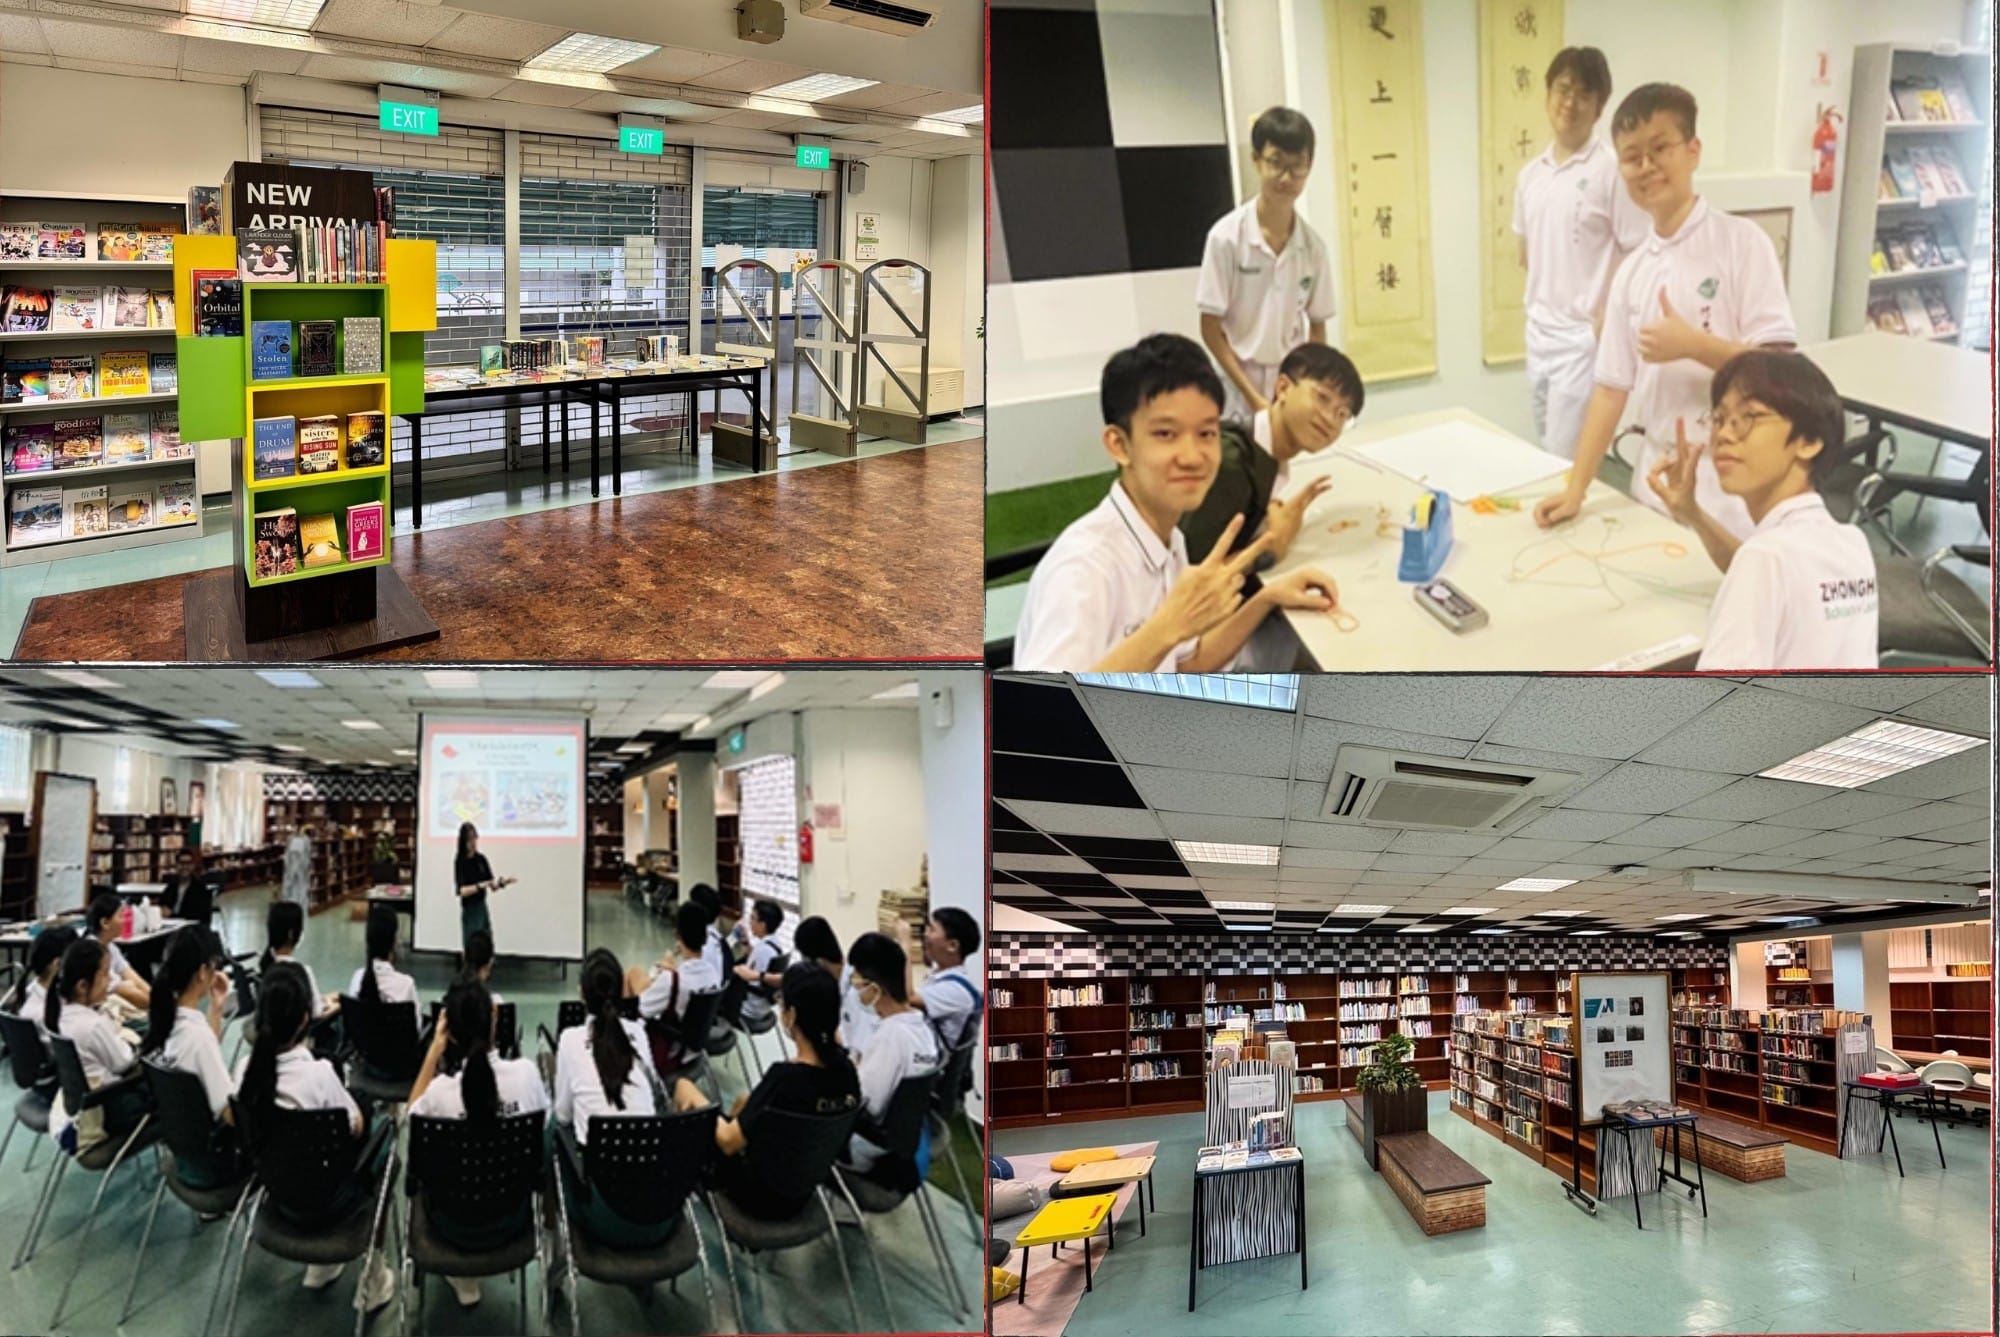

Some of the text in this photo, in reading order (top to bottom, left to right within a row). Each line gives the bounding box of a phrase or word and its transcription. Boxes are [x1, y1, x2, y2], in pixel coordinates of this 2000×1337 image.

[393, 107, 426, 129] EXIT
[629, 132, 654, 149] EXIT
[803, 149, 823, 165] EXIT
[247, 182, 312, 206] NEW
[203, 303, 241, 313] Orbital
[257, 355, 287, 363] Stolen
[303, 441, 337, 451] RISING SUN
